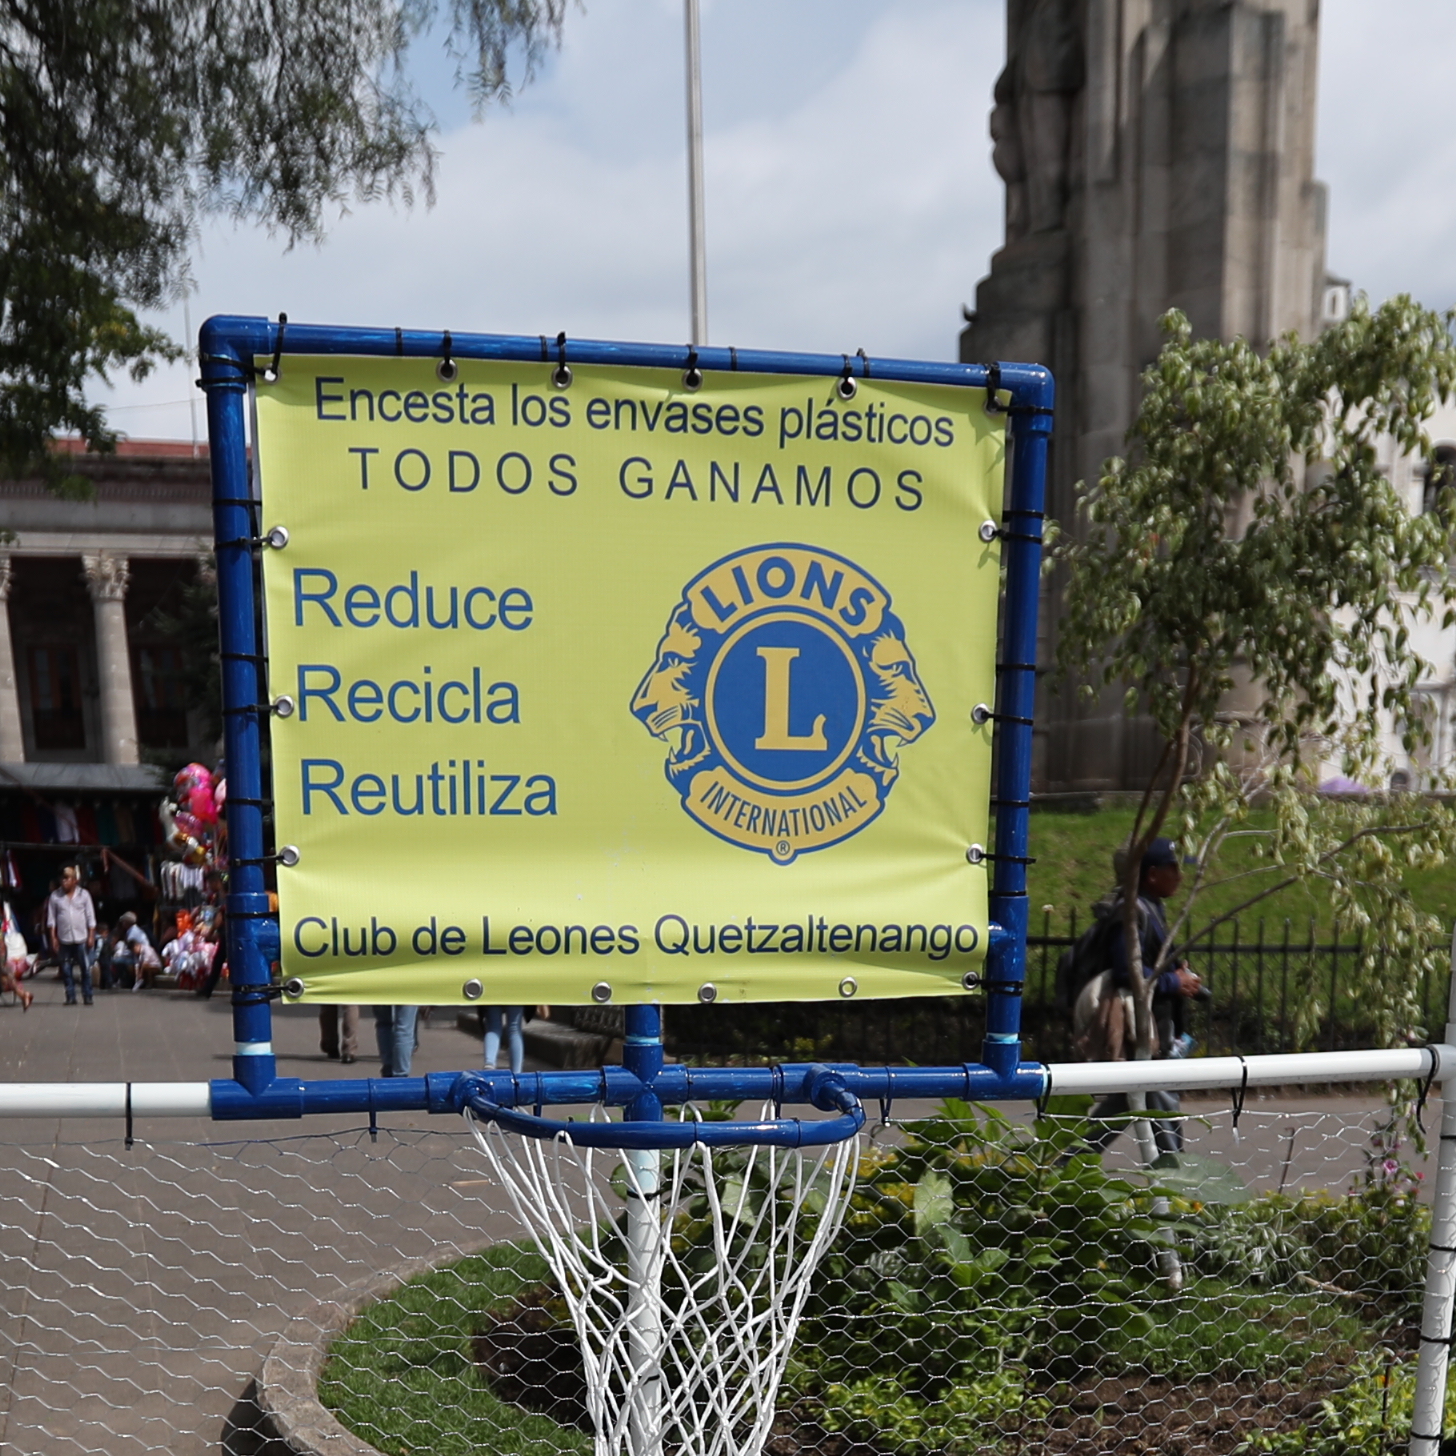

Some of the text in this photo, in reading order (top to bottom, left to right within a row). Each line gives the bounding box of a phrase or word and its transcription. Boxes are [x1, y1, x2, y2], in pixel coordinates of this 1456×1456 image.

[315, 376, 956, 448] Encesta los envases plásticos
[348, 446, 924, 511] TODOS GANAMOS
[293, 568, 534, 631] Reduce
[712, 556, 877, 621] LIONS
[297, 664, 520, 724] Recicla
[755, 646, 828, 752] L
[301, 758, 557, 817] Reutiliza
[699, 780, 868, 837] INTERNATIONAL
[294, 914, 979, 959] Club de Leones Quetzaltenango
